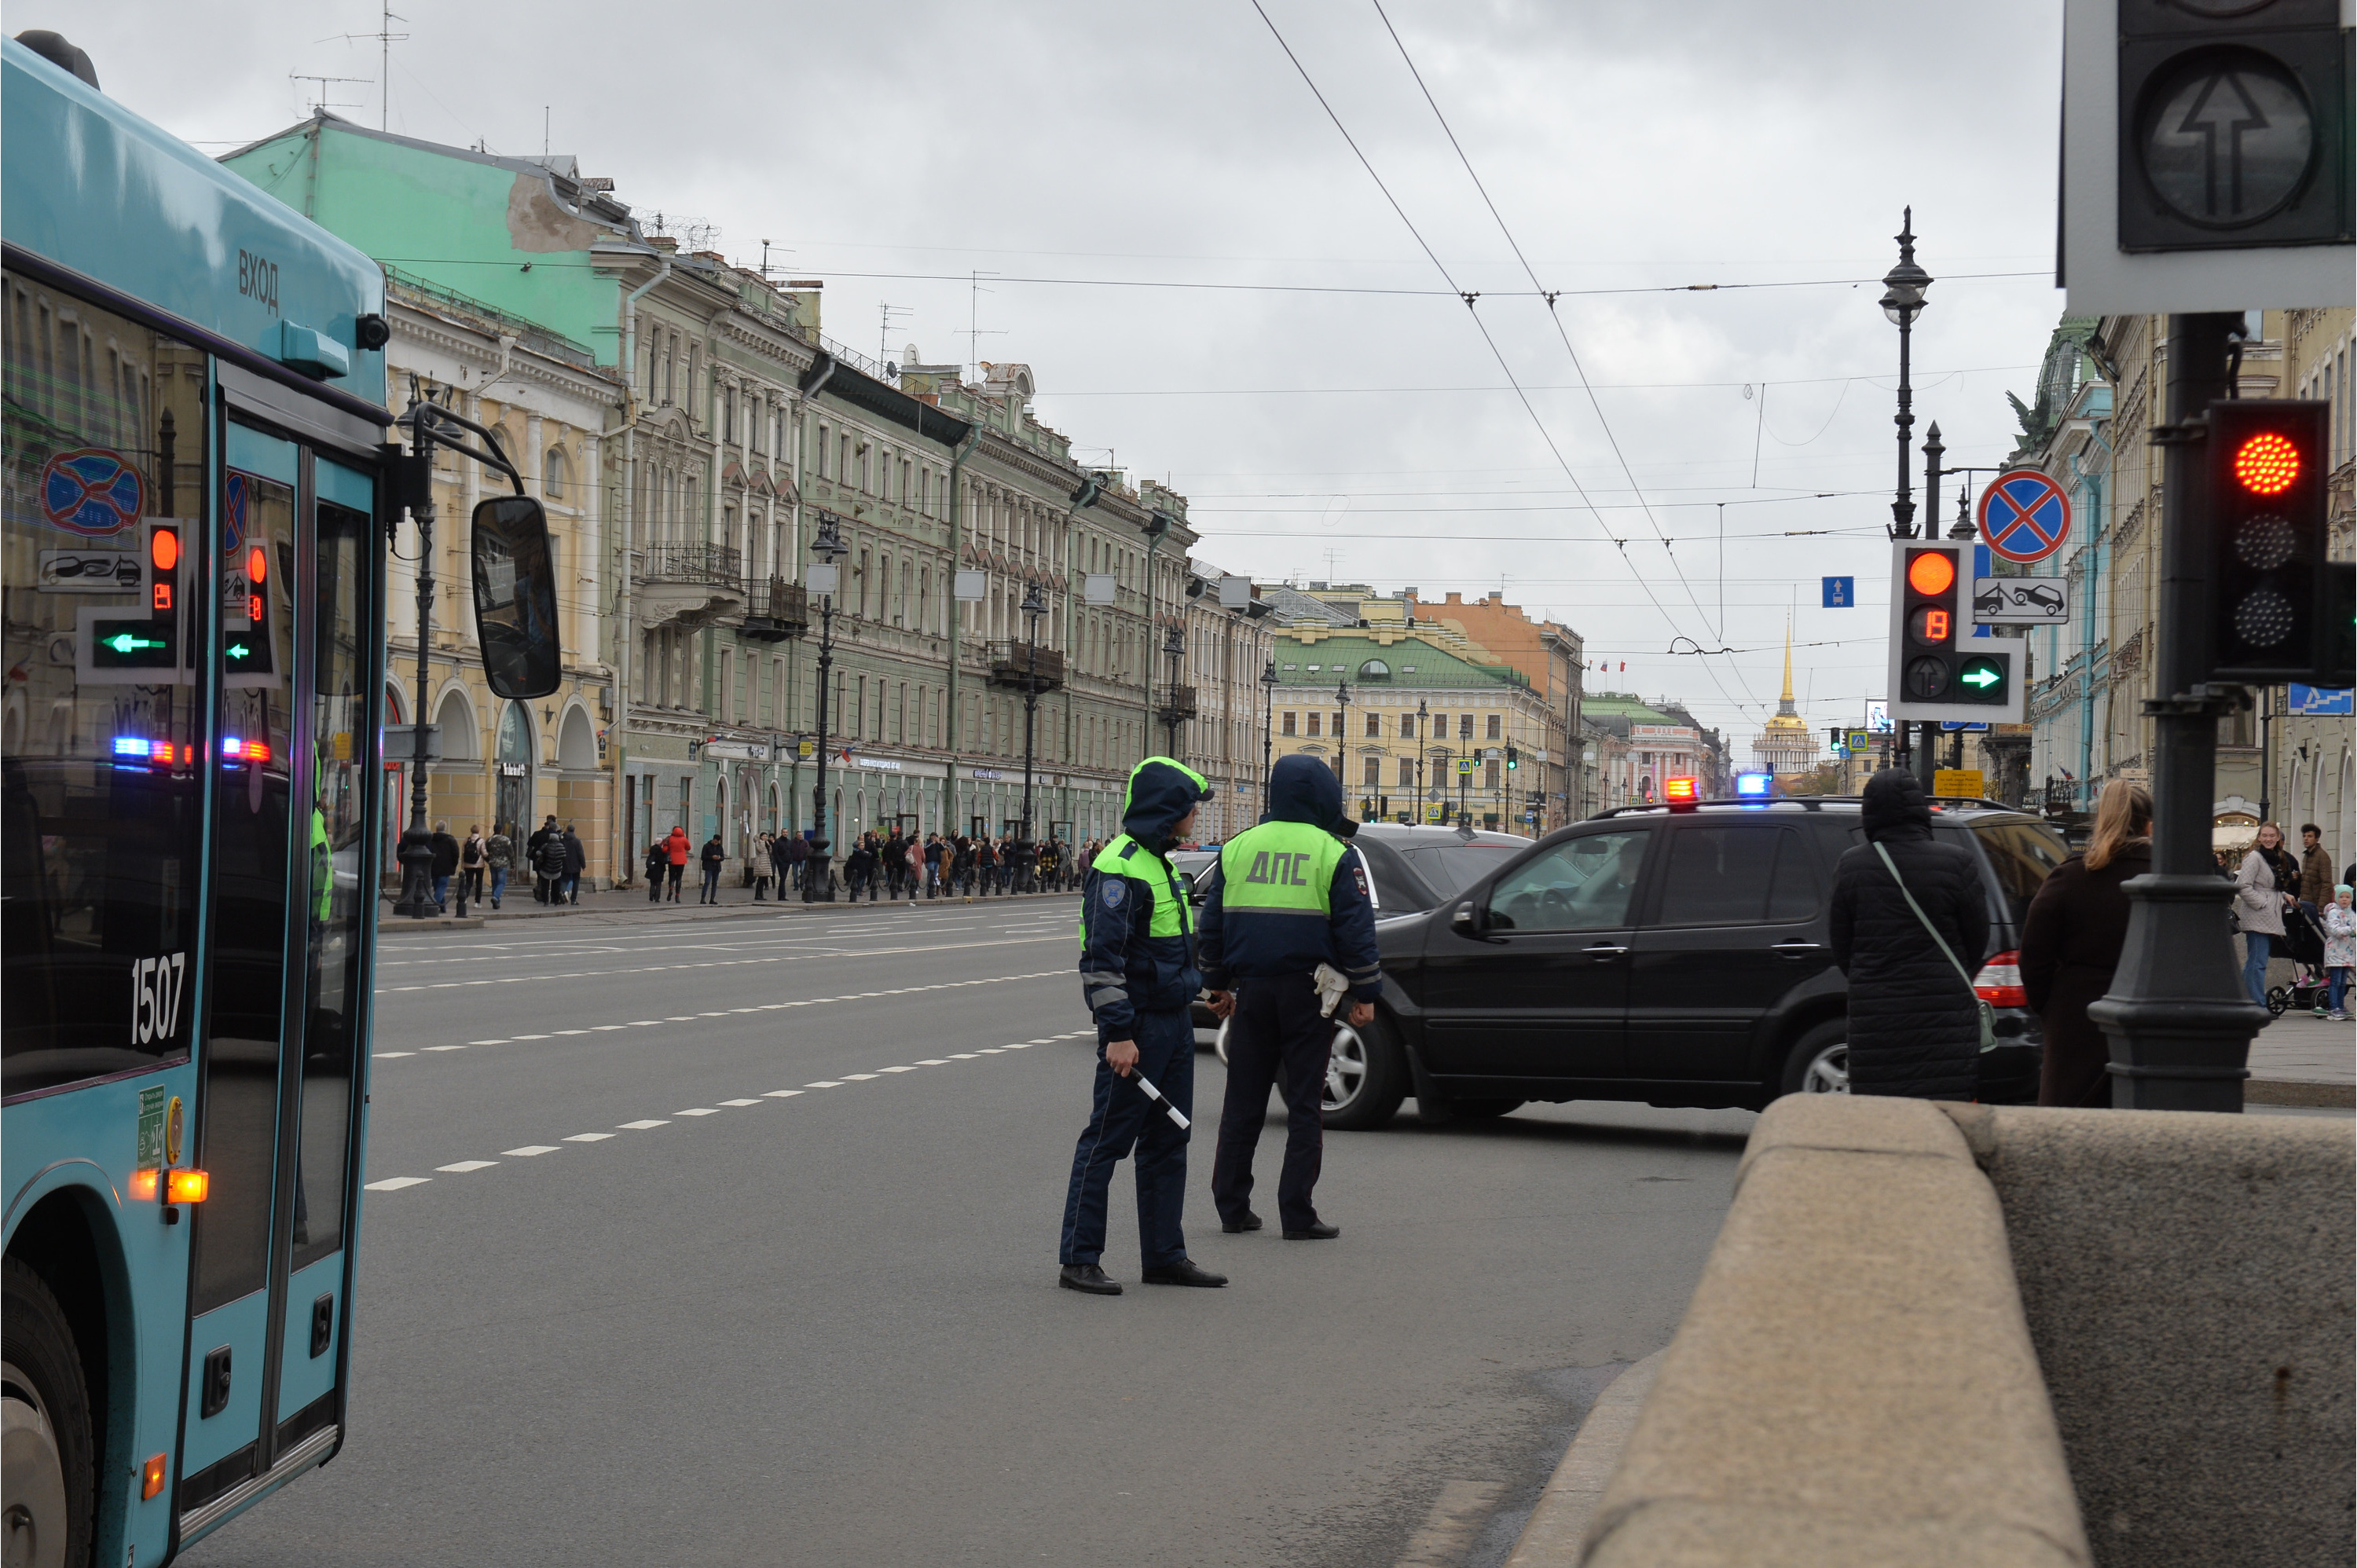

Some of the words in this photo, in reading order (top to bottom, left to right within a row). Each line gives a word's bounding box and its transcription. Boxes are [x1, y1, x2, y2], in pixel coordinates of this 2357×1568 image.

[239, 248, 278, 318] ВХОД
[1926, 610, 1948, 639] 19
[1245, 851, 1310, 886] ДПС
[132, 951, 185, 1045] 1507
